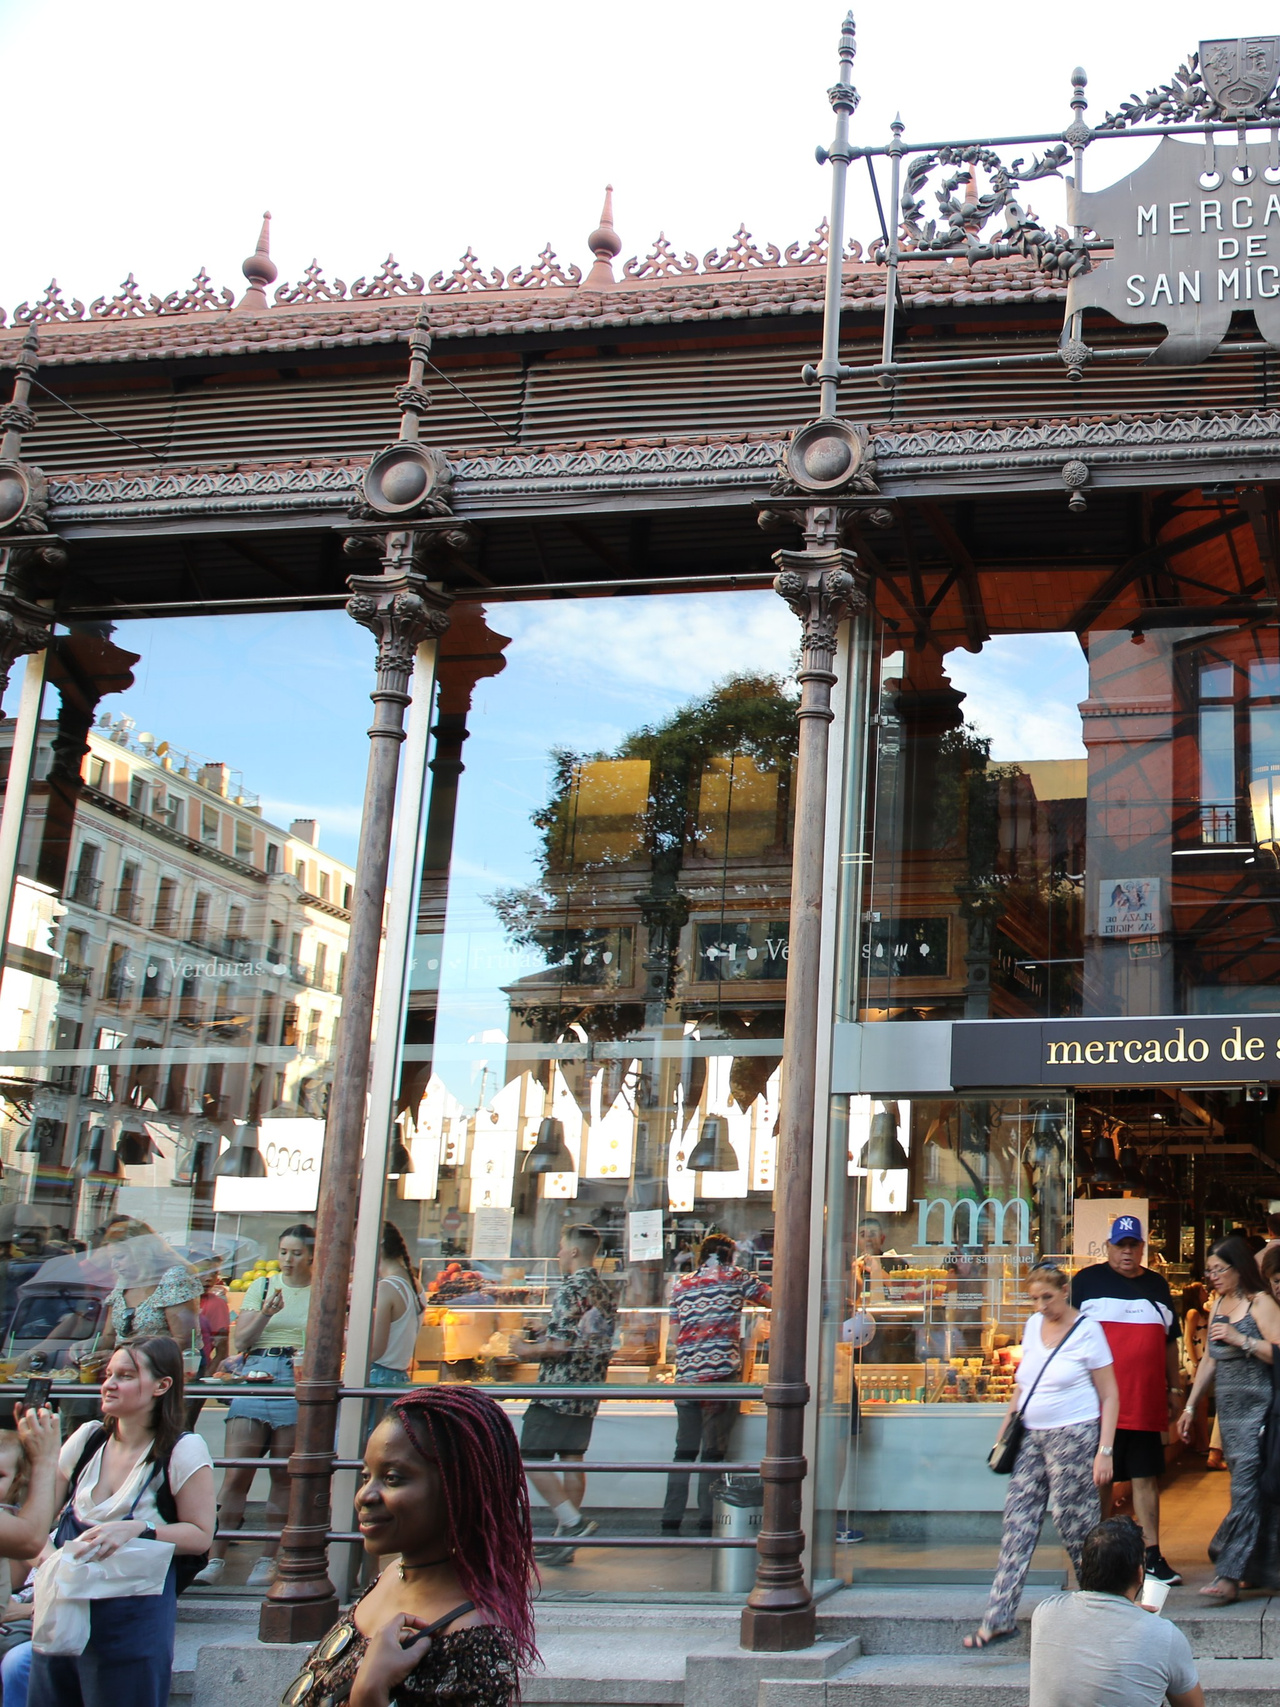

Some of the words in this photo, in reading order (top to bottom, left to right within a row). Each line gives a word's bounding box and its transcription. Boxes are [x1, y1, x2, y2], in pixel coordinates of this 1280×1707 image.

[1218, 234, 1268, 260] DE
[1126, 270, 1201, 307] SAN
[167, 956, 265, 978] Verduras
[1046, 1027, 1210, 1065] mercado
[1220, 1025, 1265, 1062] de
[961, 1253, 974, 1264] de
